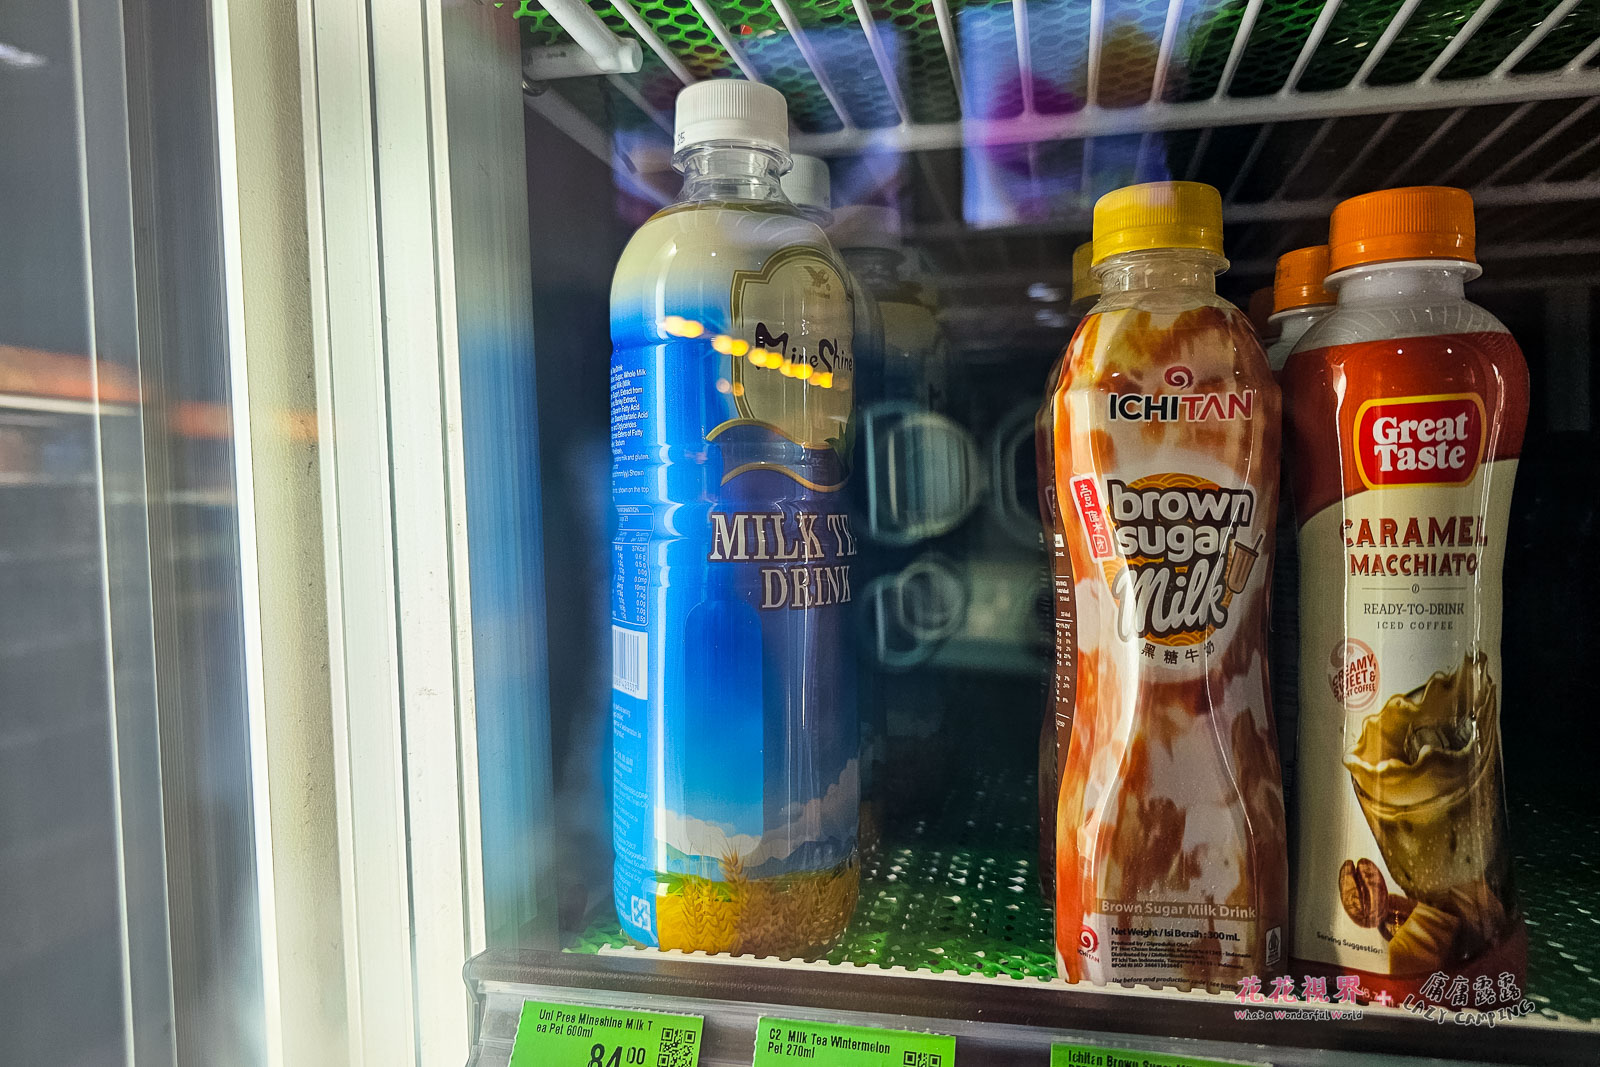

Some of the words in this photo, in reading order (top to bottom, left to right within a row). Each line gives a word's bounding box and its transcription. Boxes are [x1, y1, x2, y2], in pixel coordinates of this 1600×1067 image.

[1109, 390, 1253, 421] ICHITAN
[1372, 412, 1468, 445] Great
[1374, 441, 1466, 472] Taste
[1111, 482, 1251, 522] brown
[709, 514, 825, 560] MILK
[827, 514, 858, 557] TE
[1117, 525, 1233, 563] sugar
[1339, 516, 1488, 548] CARAMEL
[1350, 552, 1478, 577] MACCHIATO
[761, 565, 852, 609] DRINK
[1113, 558, 1227, 643] Milk
[1364, 602, 1465, 616] READY-TO-DRINK
[1377, 621, 1404, 630] ICED
[1409, 621, 1454, 630] COFFEE
[1141, 642, 1215, 665] 黑糖牛奶
[1354, 683, 1376, 695] COFFEE
[1101, 900, 1143, 914] Brown
[1145, 902, 1184, 917] Sugar
[1188, 903, 1217, 917] Milk
[1219, 905, 1257, 919] Drink
[1111, 927, 1127, 936] Net
[1128, 927, 1158, 938] Weight
[1164, 928, 1174, 937] Isi
[1174, 929, 1202, 938] Bersih
[1208, 932, 1225, 940] 300
[1225, 934, 1240, 942] mL
[1316, 931, 1342, 946] Serving
[1342, 938, 1384, 954] Suggestion
[536, 1024, 547, 1033] ea
[549, 1024, 564, 1036] Pet
[566, 1025, 594, 1038] 600ml
[539, 1008, 554, 1020] Uni
[556, 1010, 576, 1024] Pres
[578, 1013, 623, 1029] Mineshine
[626, 1018, 644, 1031] Milk
[647, 1020, 653, 1031] T
[768, 1042, 782, 1055] Pet
[786, 1044, 815, 1058] 270ml
[769, 1028, 782, 1041] C2
[788, 1030, 808, 1044] Milk
[811, 1033, 828, 1046] Tea
[830, 1036, 890, 1054] Wintermelon
[587, 1043, 623, 1067] 84
[626, 1046, 646, 1065] 00
[1068, 1050, 1103, 1066] Ichitan
